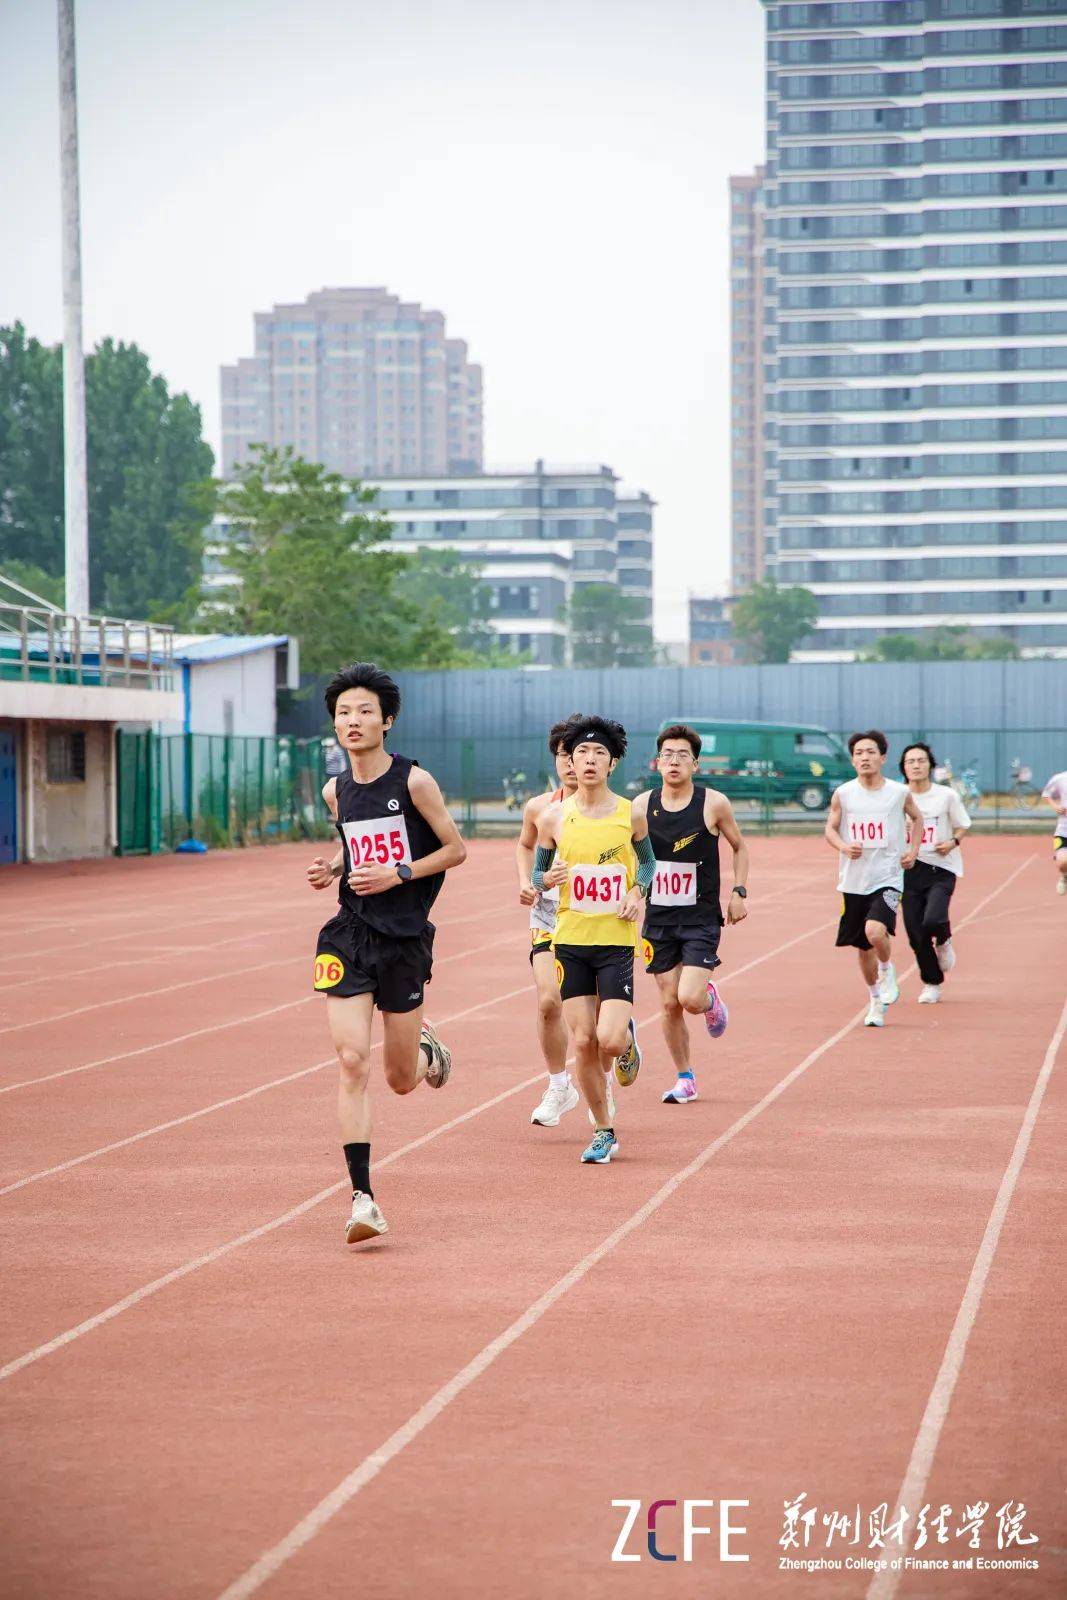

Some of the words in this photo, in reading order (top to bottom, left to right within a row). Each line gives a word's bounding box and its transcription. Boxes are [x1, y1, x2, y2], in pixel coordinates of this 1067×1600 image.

[852, 822, 883, 840] 1101
[350, 831, 405, 866] 0255
[573, 875, 621, 902] 0437
[656, 872, 692, 895] 1107
